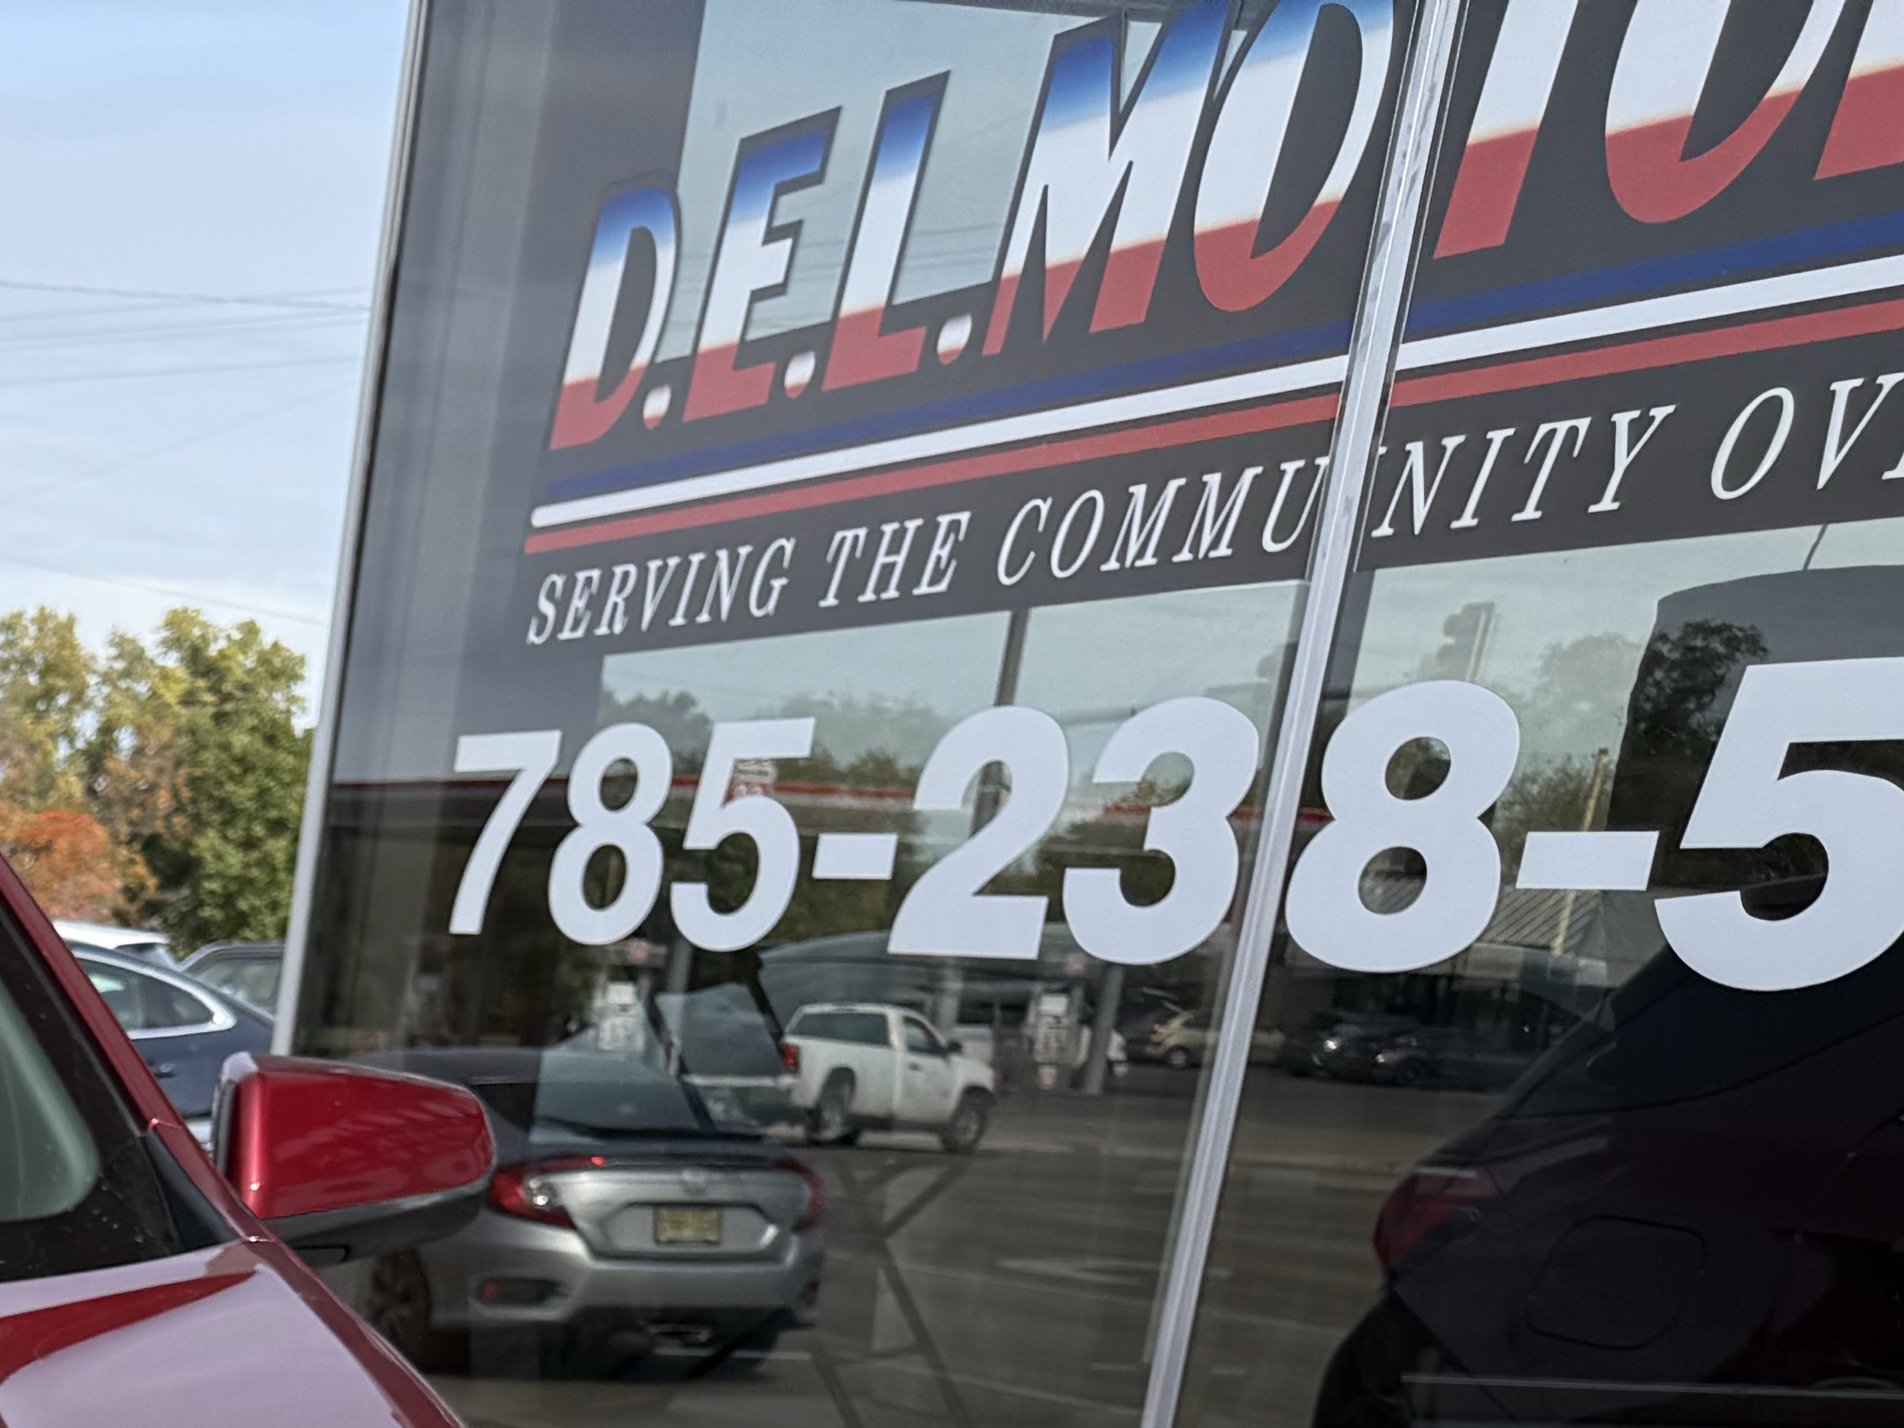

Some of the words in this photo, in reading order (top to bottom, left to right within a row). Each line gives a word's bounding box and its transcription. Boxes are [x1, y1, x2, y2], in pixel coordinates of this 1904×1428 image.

[527, 538, 796, 645] SERVING
[818, 511, 972, 608] THE
[996, 404, 1676, 586] COMMUNITY
[1710, 370, 1904, 501] OV
